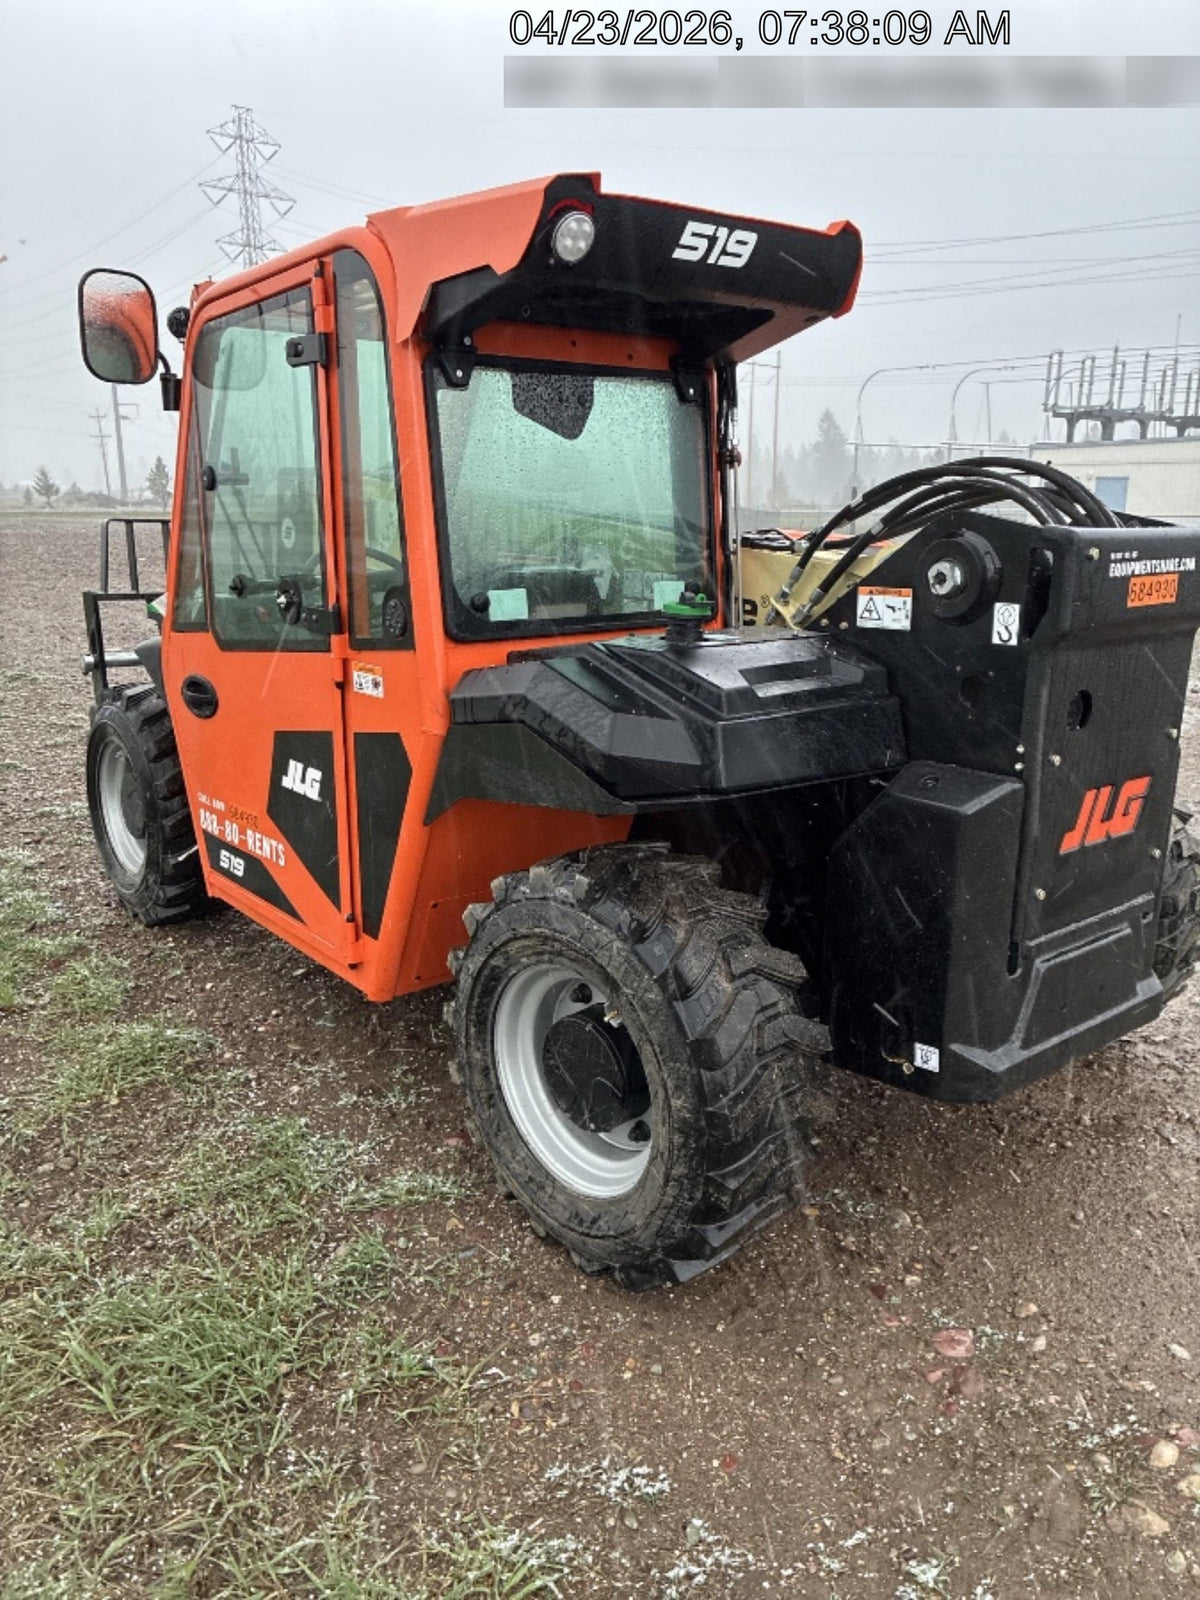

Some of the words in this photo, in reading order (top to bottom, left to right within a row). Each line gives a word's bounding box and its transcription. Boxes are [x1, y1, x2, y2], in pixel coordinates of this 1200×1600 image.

[672, 220, 758, 269] 519
[281, 758, 322, 802] JLG
[1058, 775, 1152, 855] JLG
[219, 849, 245, 877] 519
